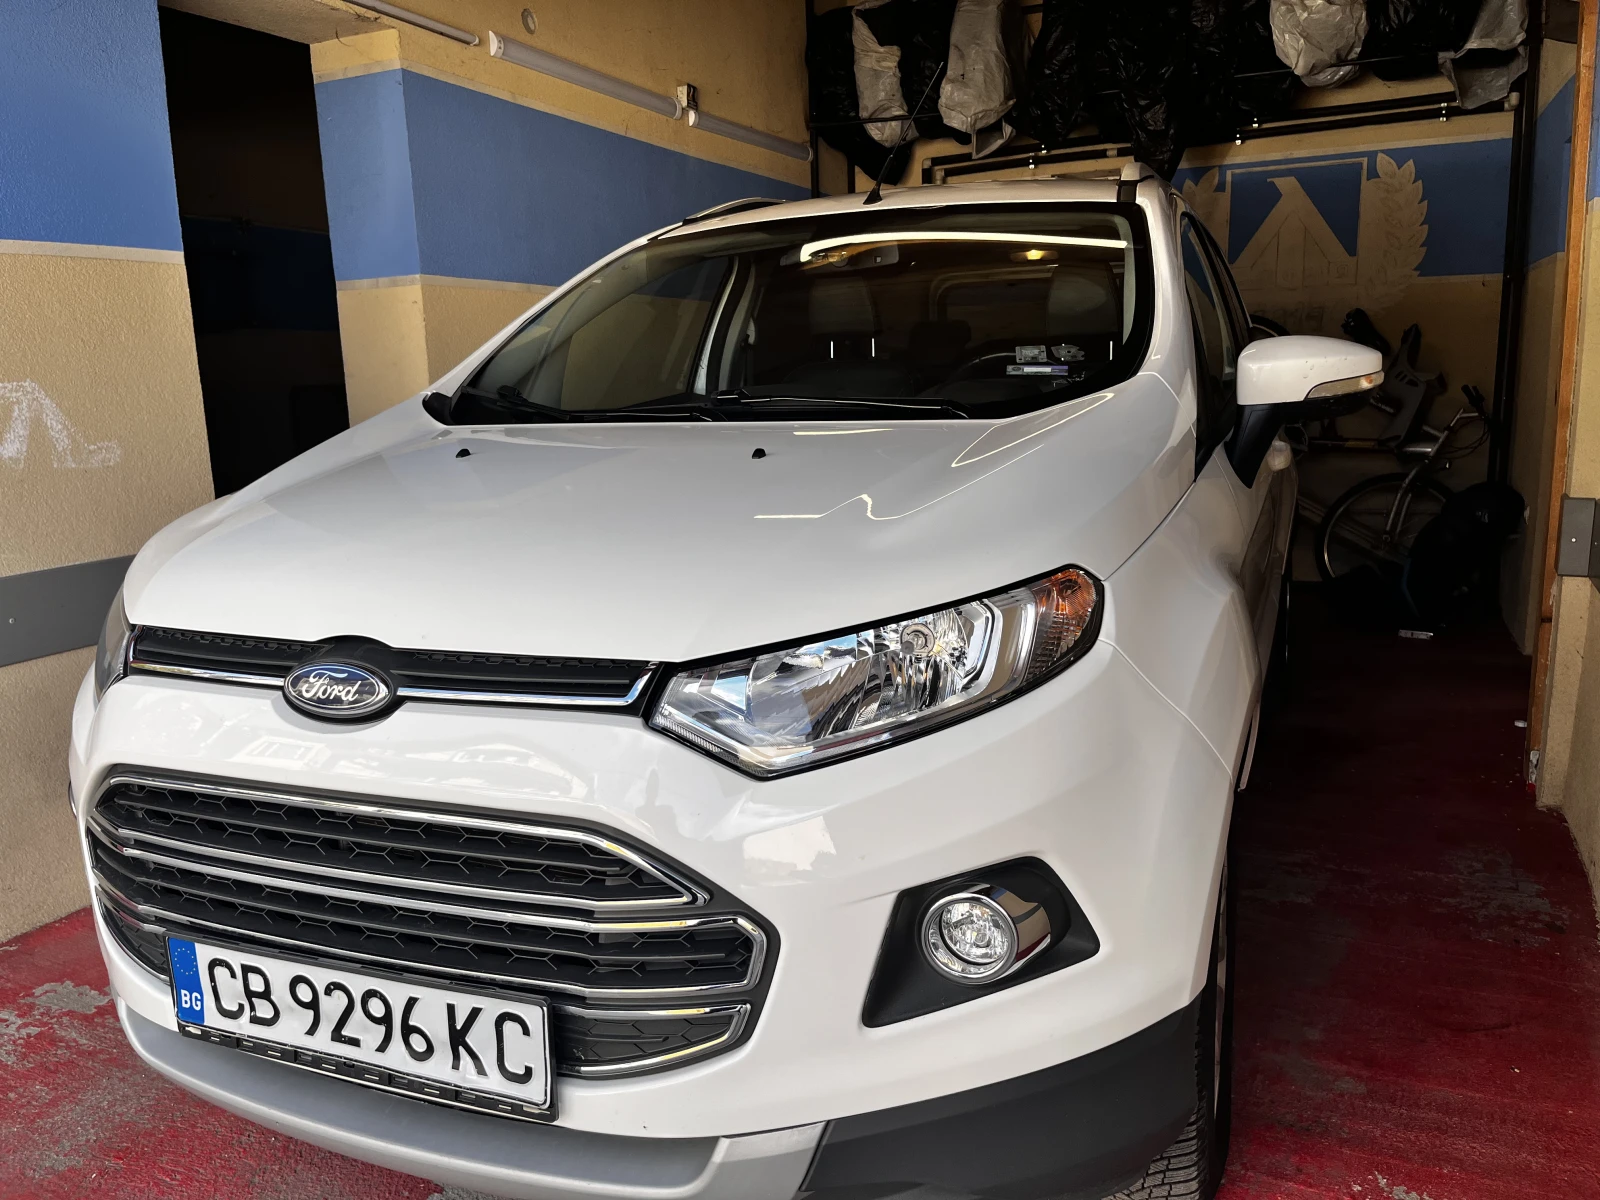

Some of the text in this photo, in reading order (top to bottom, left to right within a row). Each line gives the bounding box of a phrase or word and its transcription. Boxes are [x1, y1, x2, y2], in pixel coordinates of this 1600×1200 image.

[302, 670, 361, 701] Ford
[180, 989, 202, 1011] BG
[208, 957, 533, 1085] CB 9296 KC
